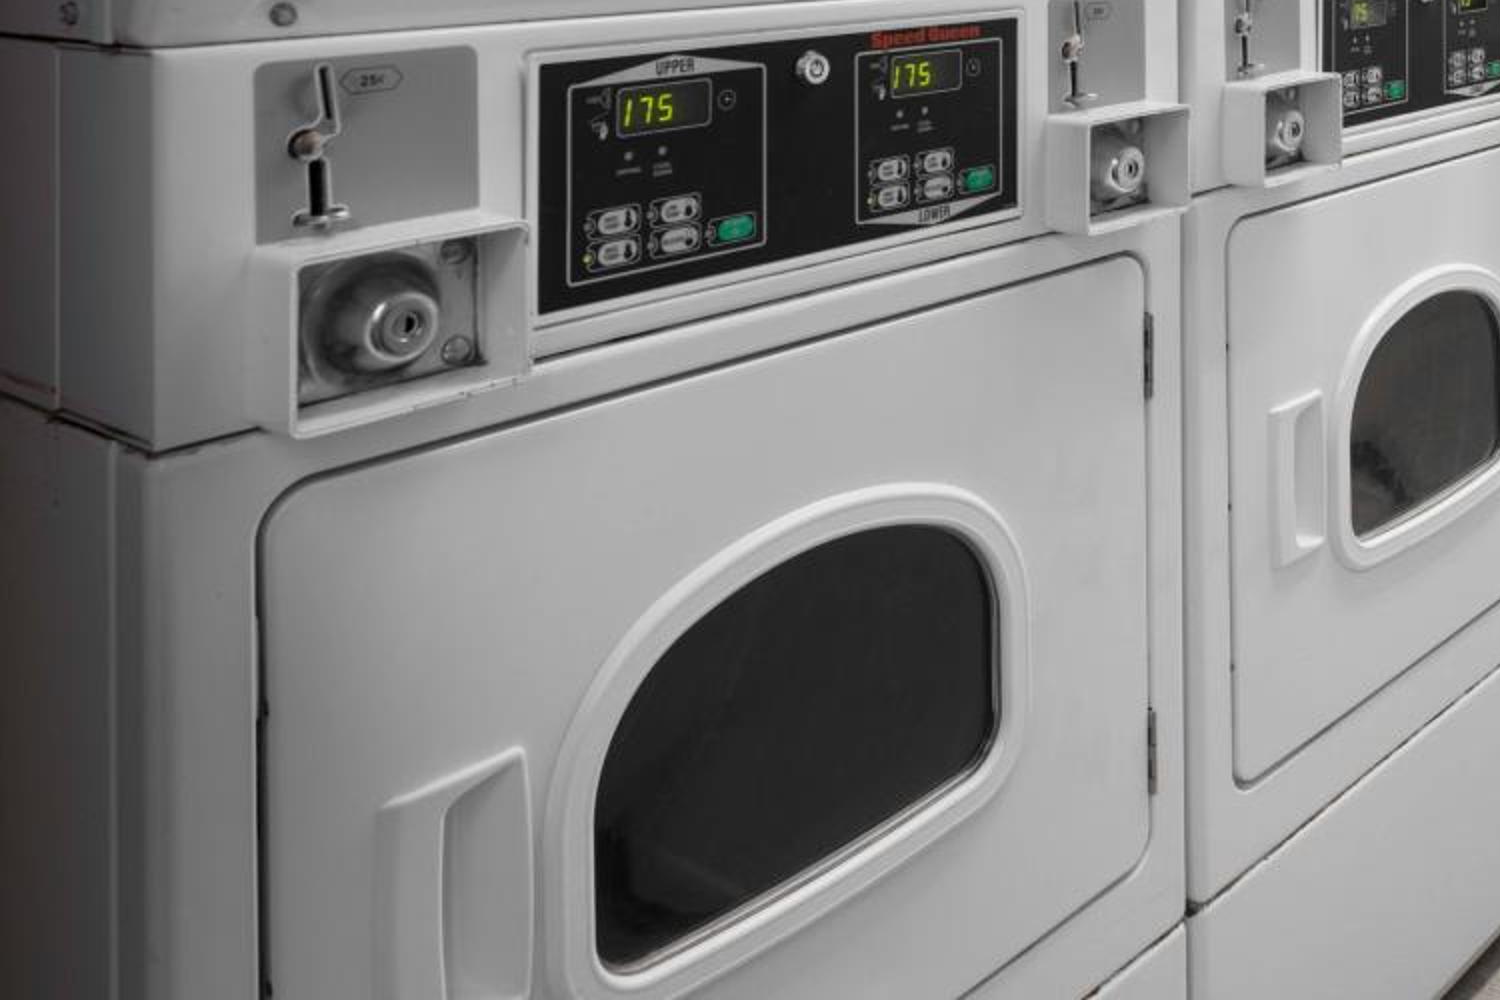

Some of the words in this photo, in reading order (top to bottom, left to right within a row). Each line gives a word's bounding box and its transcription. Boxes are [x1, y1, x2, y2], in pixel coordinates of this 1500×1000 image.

[655, 57, 695, 77] UPPER
[893, 61, 931, 89] 175
[624, 93, 673, 127] 175
[919, 204, 951, 224] LOWER
